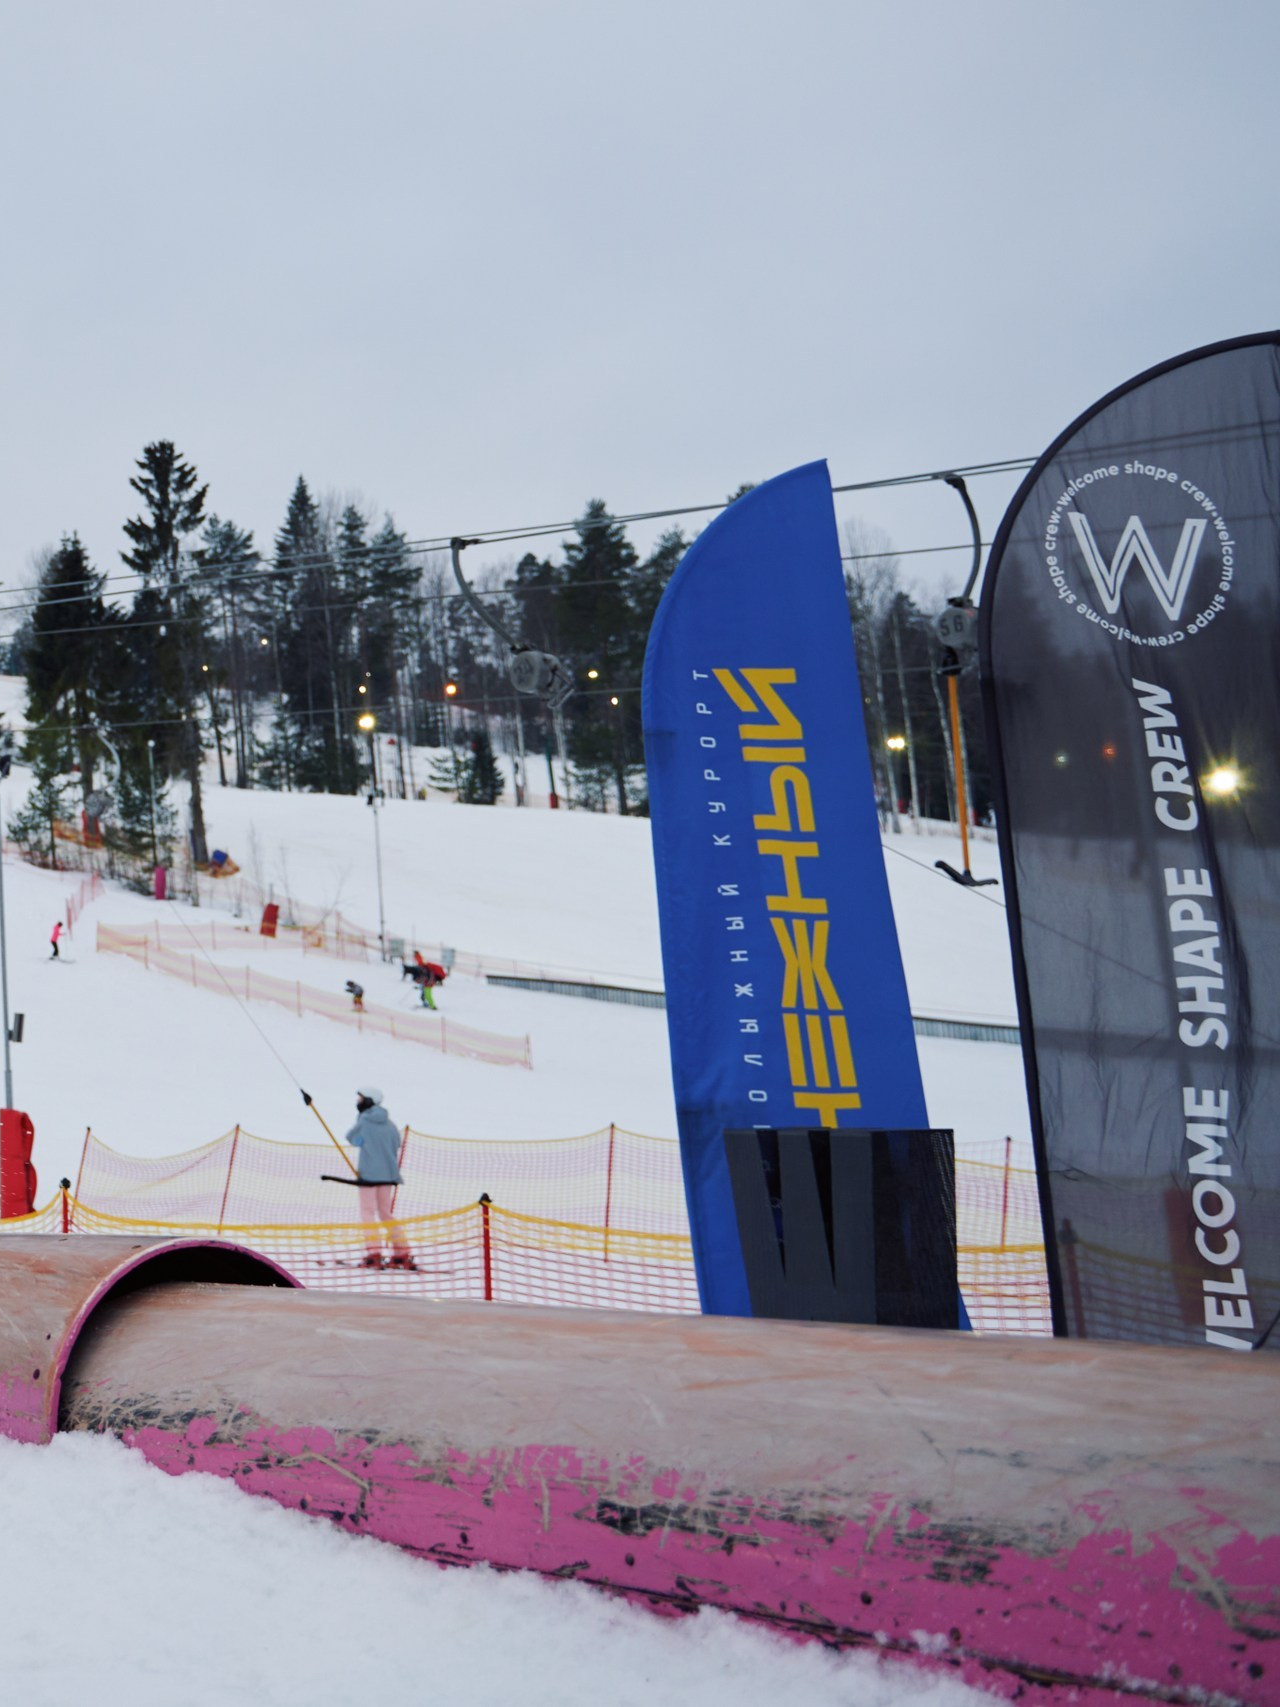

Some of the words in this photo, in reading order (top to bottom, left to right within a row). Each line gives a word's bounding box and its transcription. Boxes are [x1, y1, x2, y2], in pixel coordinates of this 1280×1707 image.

[1057, 464, 1119, 506] welcome
[1124, 460, 1178, 483] shape
[1180, 480, 1217, 512] crew
[1045, 510, 1061, 551] crew
[1067, 511, 1208, 621] W
[1213, 516, 1235, 591] welcome
[1046, 555, 1077, 604] shape
[938, 615, 964, 636] 56
[1076, 602, 1142, 645] welcome
[1187, 593, 1225, 634] shape
[1148, 631, 1185, 647] crew
[692, 670, 731, 846] КУРОРТ
[1132, 677, 1199, 831] CREW
[1164, 867, 1229, 1050] SHAPE
